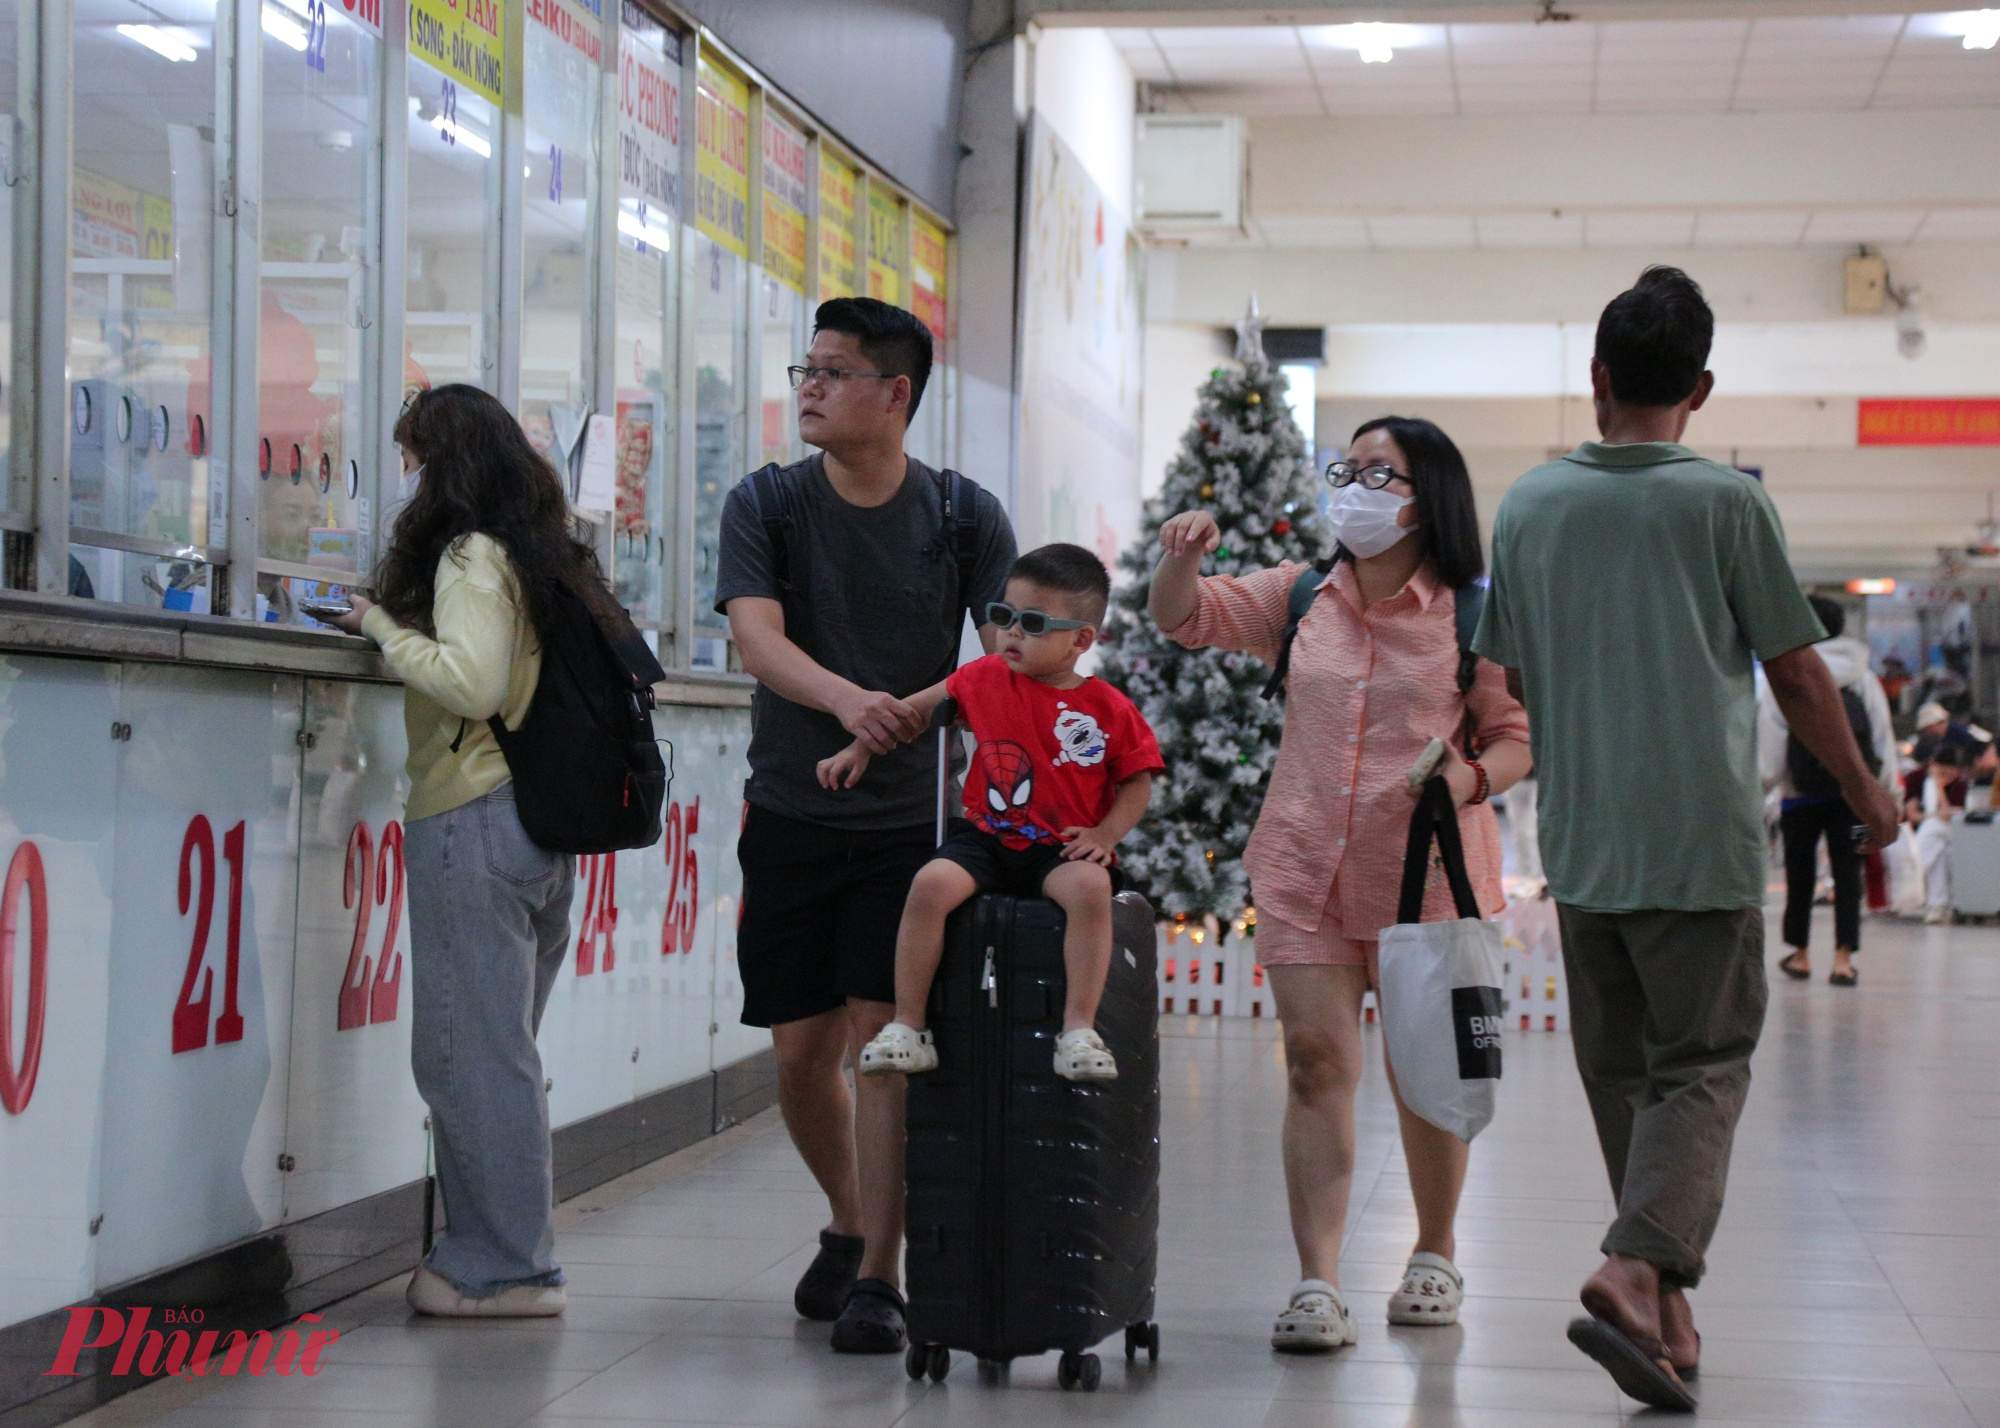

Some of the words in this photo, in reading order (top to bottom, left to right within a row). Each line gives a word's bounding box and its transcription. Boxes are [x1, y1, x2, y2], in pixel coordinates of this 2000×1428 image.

[306, 0, 326, 73] 22
[416, 8, 444, 60] SONG
[475, 43, 501, 96] NÔNG
[527, 0, 573, 43] EIKU
[441, 78, 456, 146] 23
[637, 62, 679, 146] PHONG
[549, 144, 562, 205] 24
[575, 850, 618, 977] 24
[661, 794, 700, 955] 25
[172, 814, 246, 1055] 21
[338, 820, 404, 1031] 22
